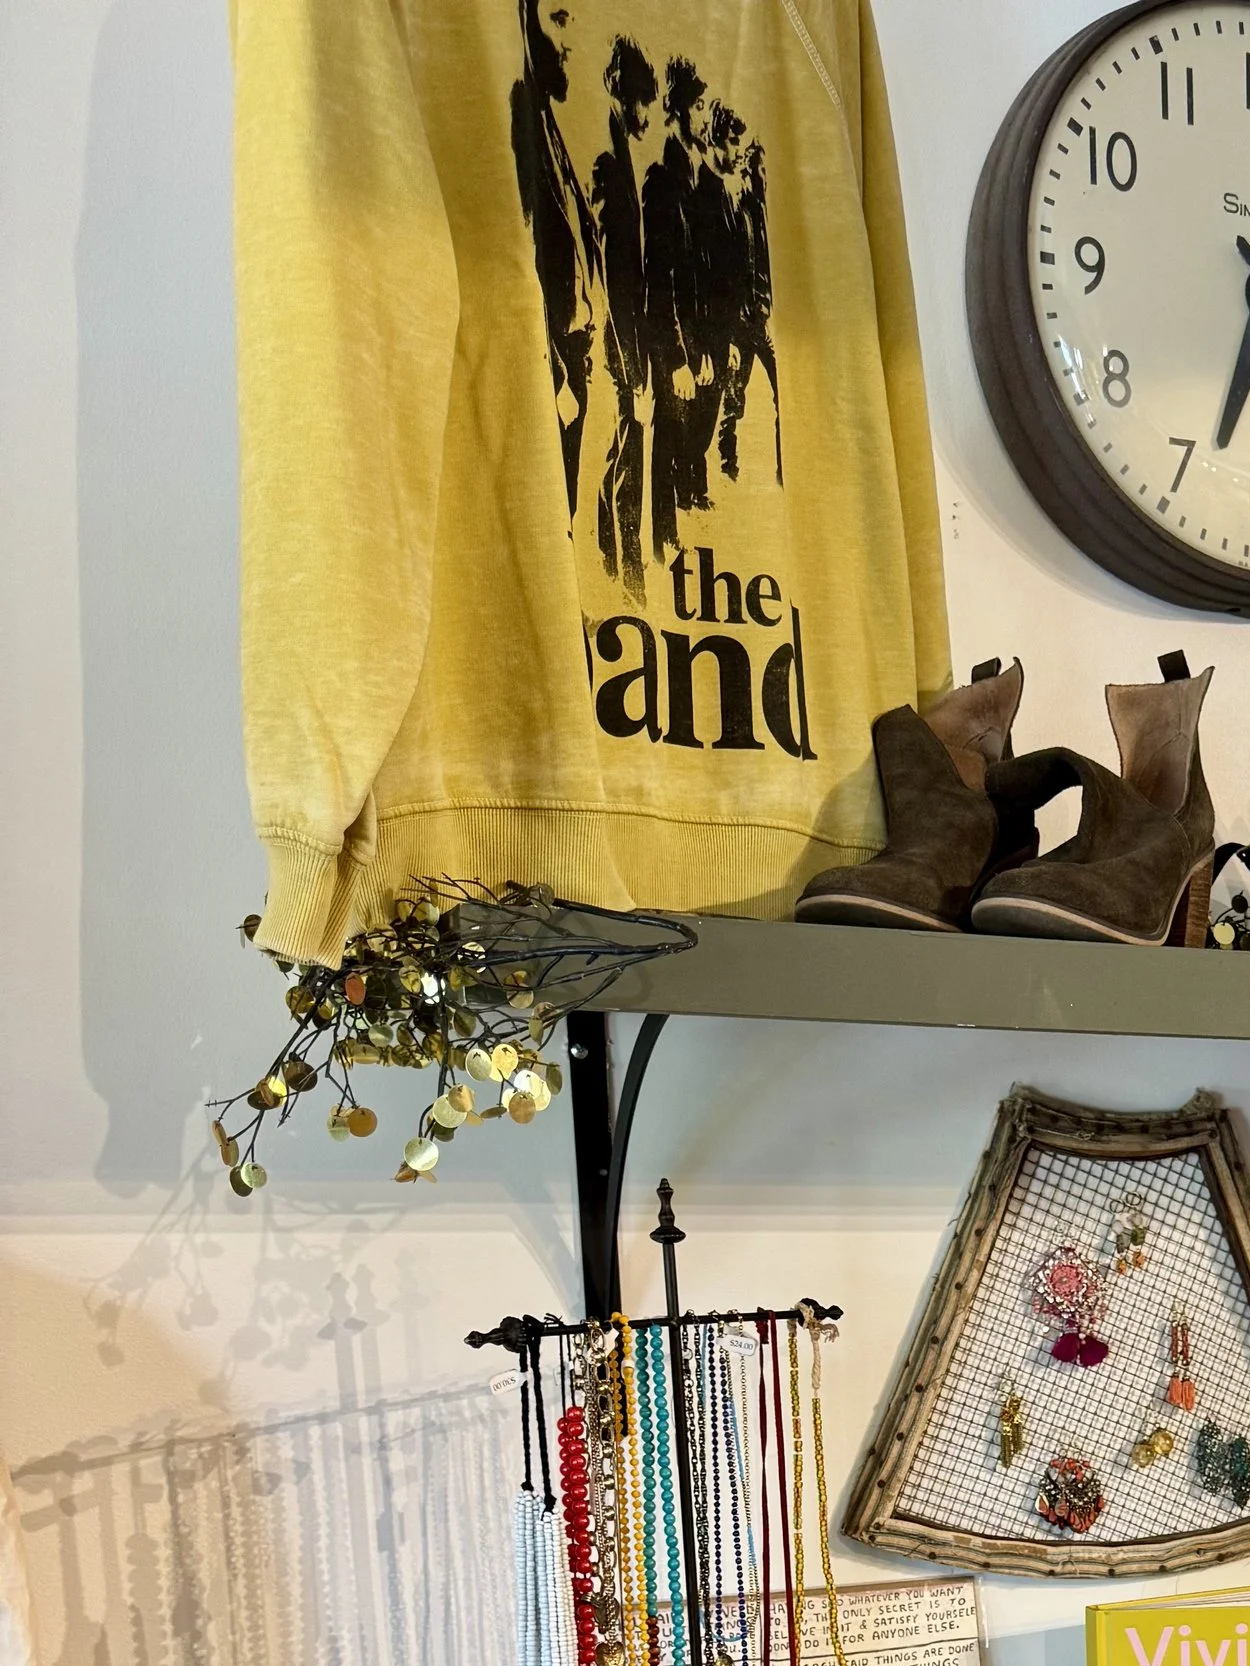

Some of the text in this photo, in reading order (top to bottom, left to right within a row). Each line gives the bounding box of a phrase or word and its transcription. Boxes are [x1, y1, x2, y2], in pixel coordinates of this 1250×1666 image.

[1160, 61, 1194, 126] 11
[1089, 126, 1138, 192] 10
[1074, 236, 1106, 295] 9
[1102, 349, 1132, 408] 8
[1169, 436, 1197, 493] 7
[669, 546, 782, 627] the
[582, 597, 817, 761] and
[842, 1607, 872, 1619] ONLY
[878, 1601, 921, 1615] SECRET
[929, 1600, 941, 1609] IS
[949, 1597, 967, 1606] TO
[848, 1591, 900, 1605] WHATEVER
[906, 1588, 925, 1599] YOU
[930, 1586, 964, 1598] WANT
[859, 1620, 868, 1630] &
[873, 1614, 919, 1628] SATISFY
[804, 1639, 820, 1649] DO
[842, 1633, 865, 1645] FOR
[872, 1625, 920, 1640] ANYONE
[927, 1620, 960, 1634] ELSE.
[873, 1651, 918, 1665] THINGS
[922, 1647, 943, 1658] ARE
[948, 1643, 975, 1655] DONE
